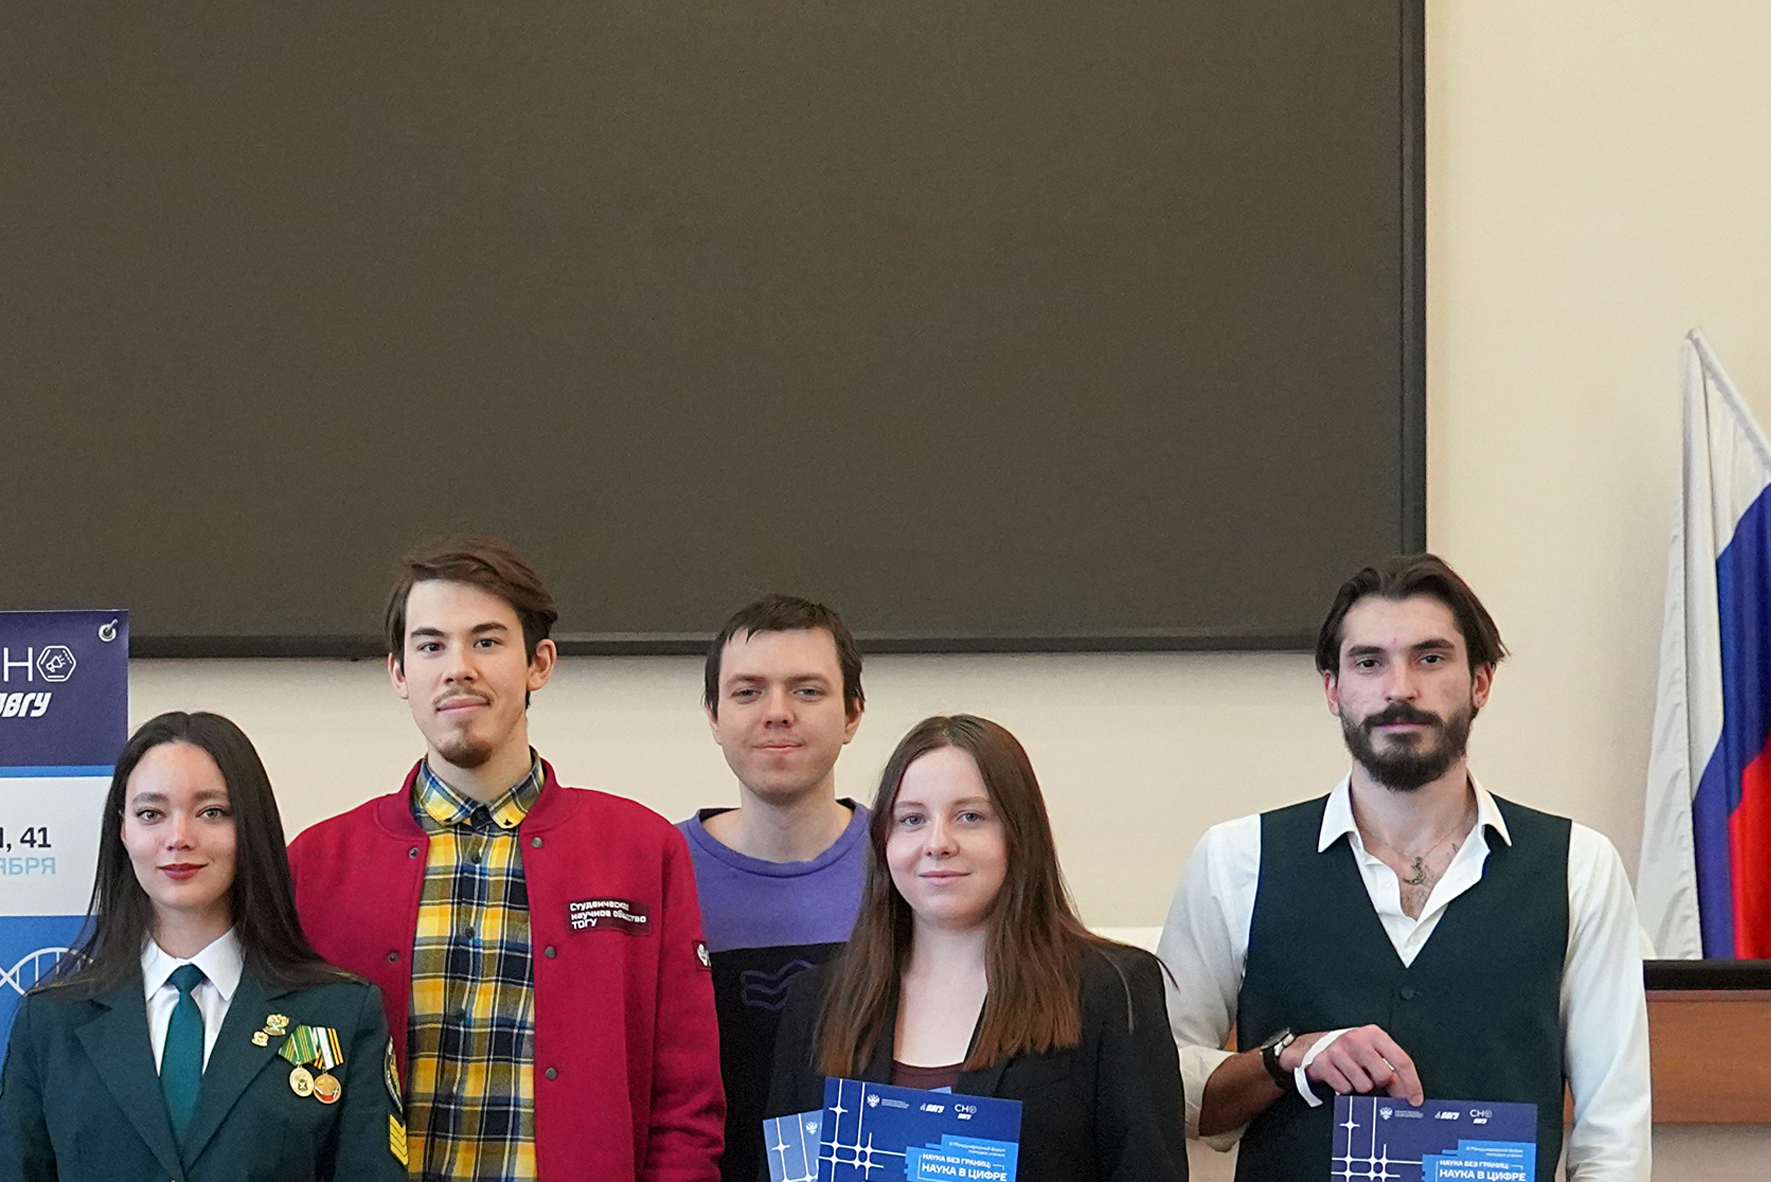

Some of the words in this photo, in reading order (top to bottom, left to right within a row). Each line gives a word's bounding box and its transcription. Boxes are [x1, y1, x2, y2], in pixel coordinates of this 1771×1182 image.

[20, 826, 52, 848] 41
[571, 910, 612, 920] научное
[571, 918, 598, 930] ТОГУ
[922, 1153, 946, 1162] НАУКА
[946, 1156, 960, 1164] БЕЗ
[1464, 1160, 1478, 1168] БЕЗ
[921, 1163, 957, 1176] НАУКА
[958, 1167, 966, 1177] В
[968, 1168, 1007, 1182] ЦИФРЕ
[1439, 1169, 1475, 1180] НАУКА
[1477, 1171, 1485, 1180] В
[1487, 1171, 1526, 1182] ЦИФРЕ
